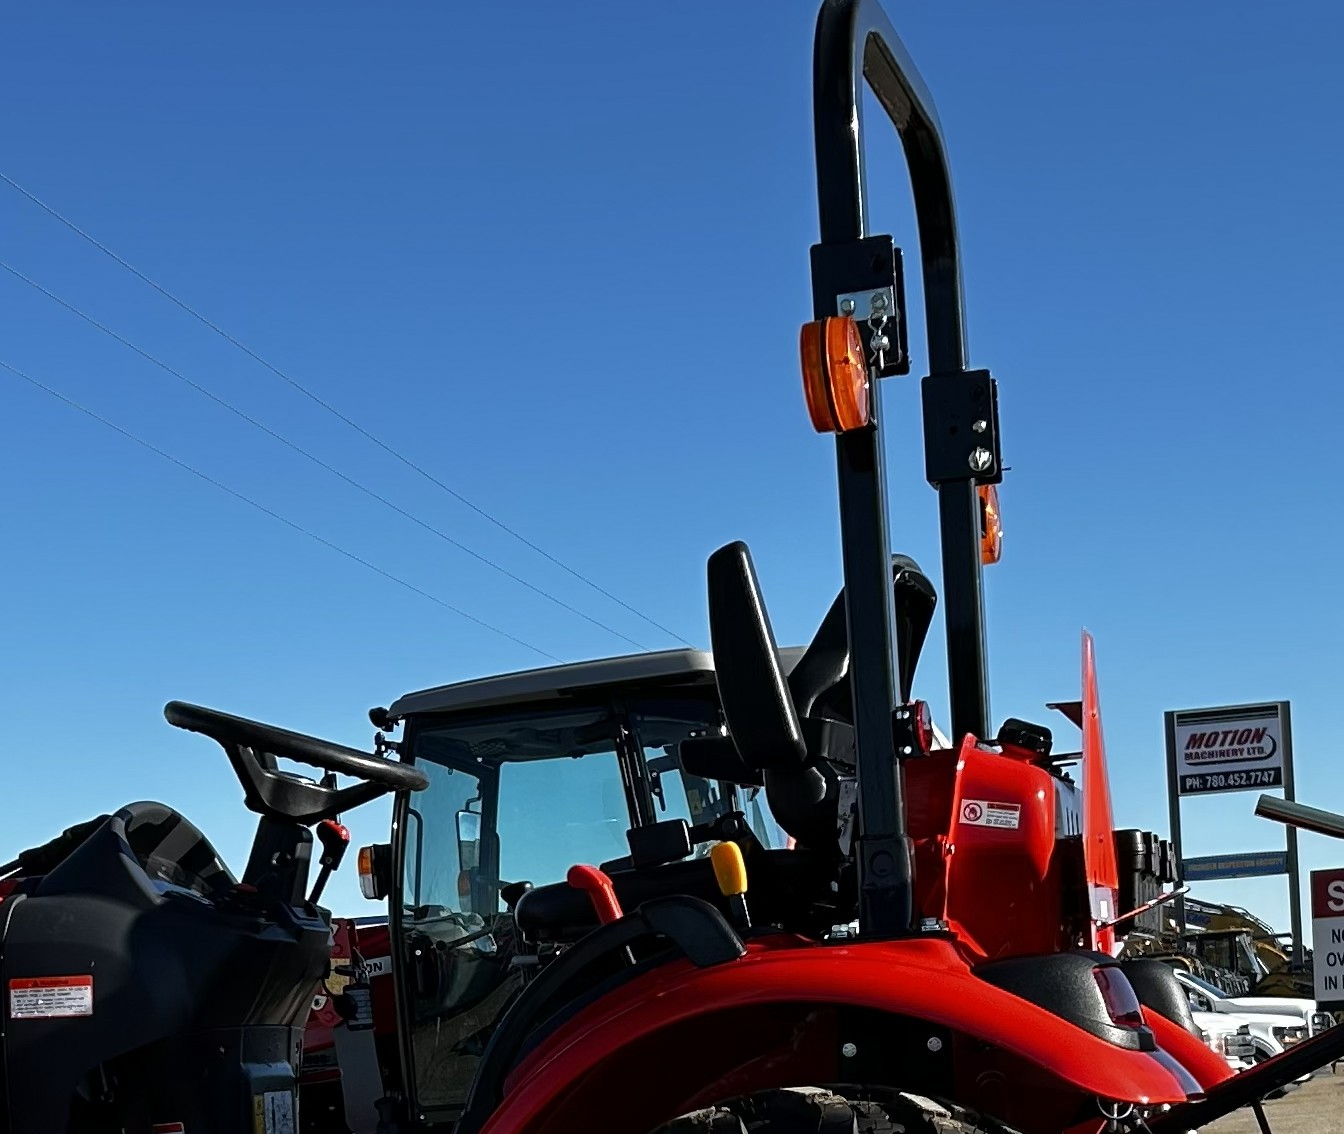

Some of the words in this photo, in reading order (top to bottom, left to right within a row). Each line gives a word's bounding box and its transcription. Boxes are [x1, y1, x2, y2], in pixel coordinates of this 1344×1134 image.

[1185, 727, 1269, 750] MOTION
[1184, 747, 1245, 761] MACHINERY
[1185, 777, 1204, 790] PH:
[1205, 770, 1275, 788] 780.452.7747
[1324, 975, 1338, 990] IN
